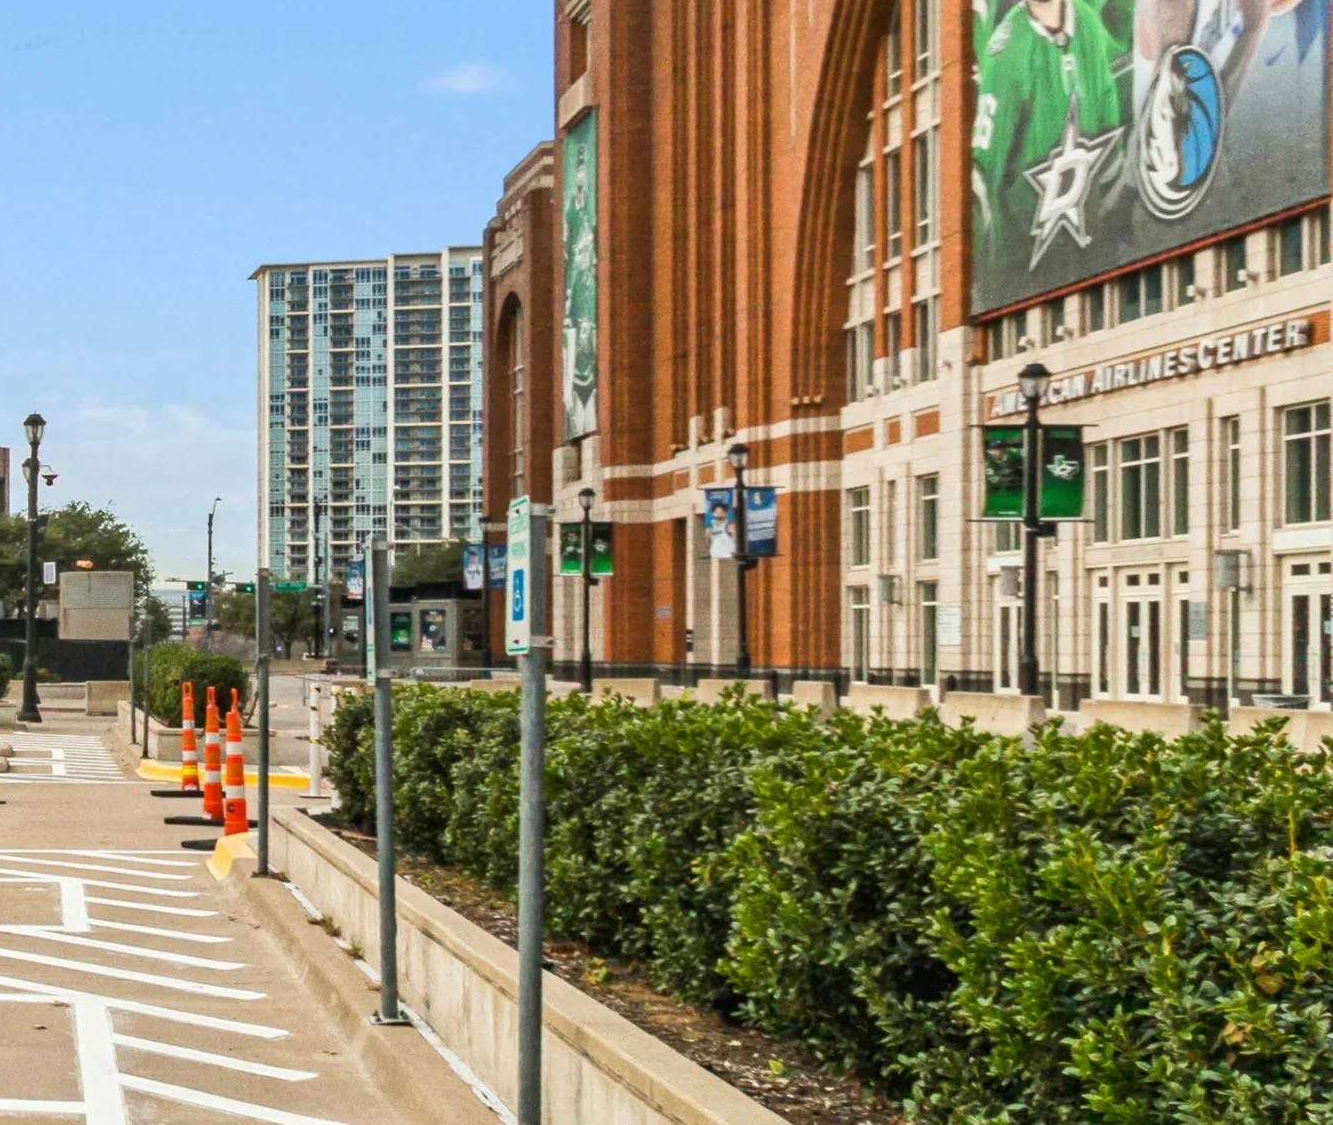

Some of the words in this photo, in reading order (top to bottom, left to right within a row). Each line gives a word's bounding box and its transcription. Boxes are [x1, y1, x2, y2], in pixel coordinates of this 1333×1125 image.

[991, 373, 1085, 418] AMECAN
[1091, 346, 1196, 393] AIRLINES
[1197, 318, 1310, 370] CENTER
